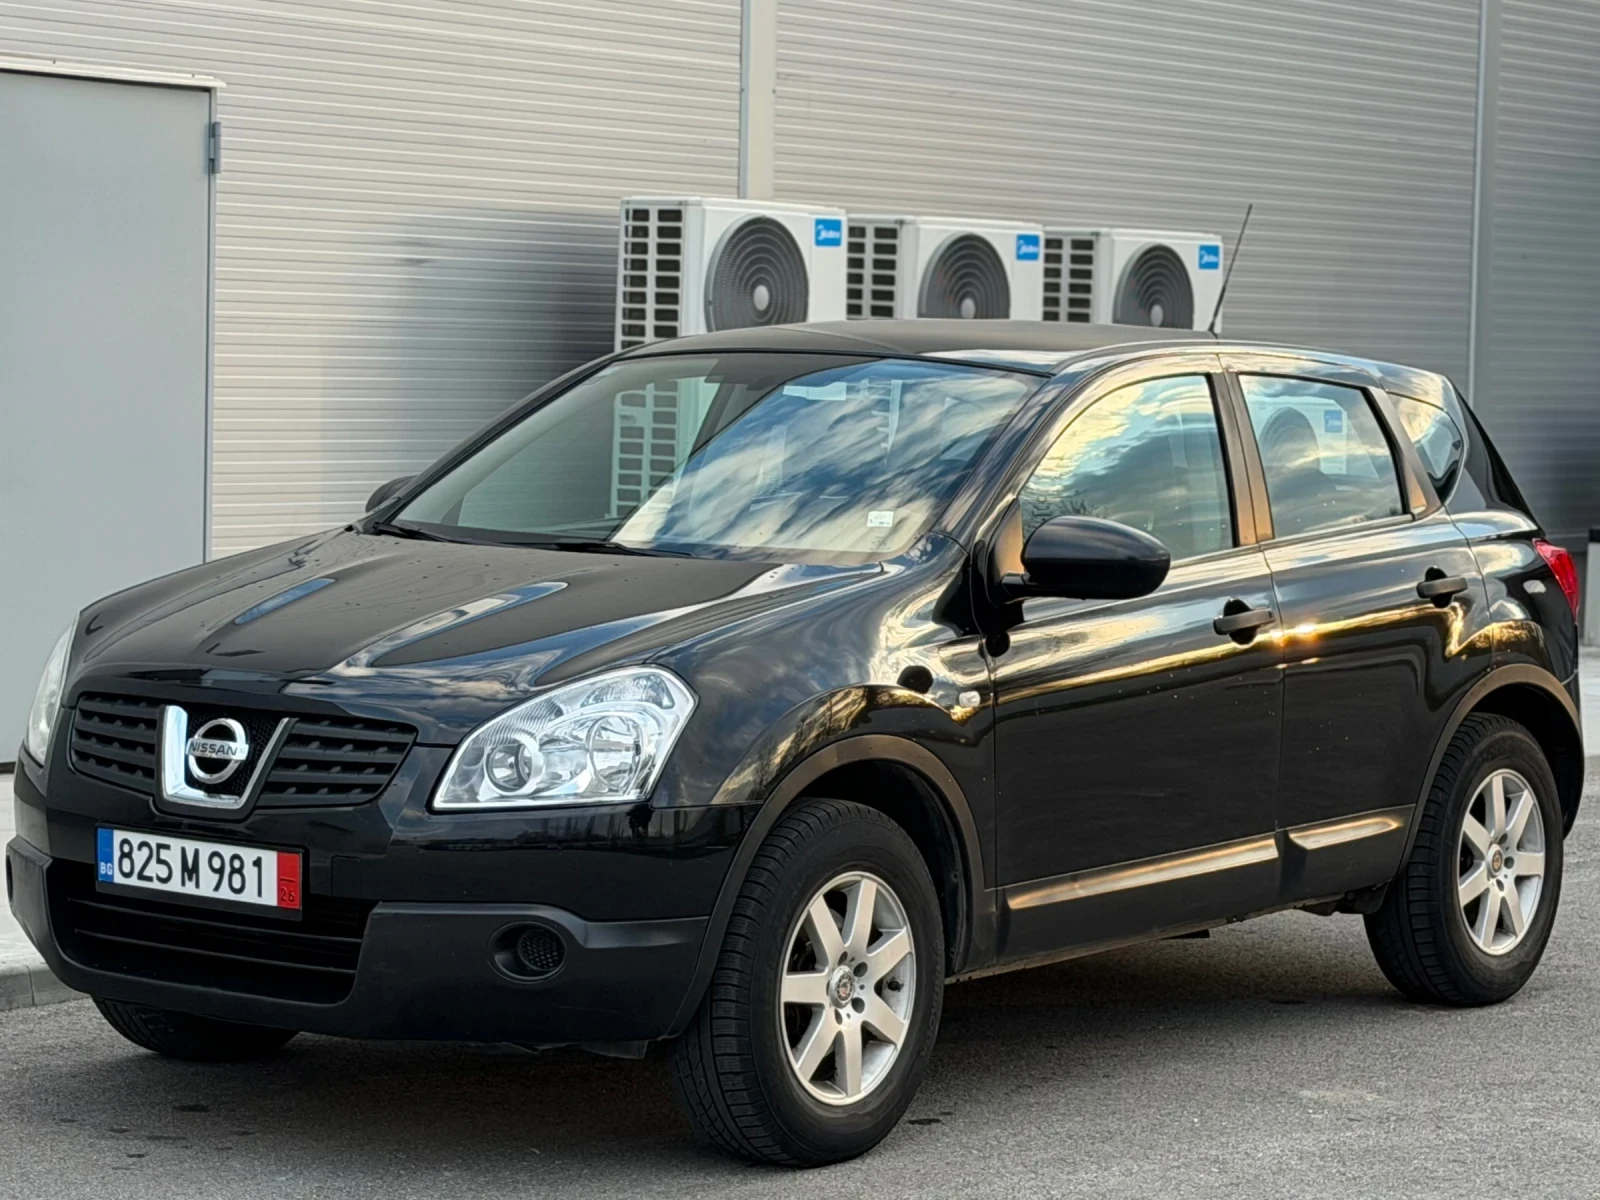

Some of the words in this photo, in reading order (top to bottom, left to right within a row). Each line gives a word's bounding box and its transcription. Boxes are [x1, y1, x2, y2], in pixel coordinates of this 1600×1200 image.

[189, 741, 238, 756] NISSAN
[99, 861, 113, 876] BG
[118, 838, 173, 884] 825
[180, 846, 200, 889] M
[207, 850, 263, 898] 981
[280, 887, 295, 903] 26
